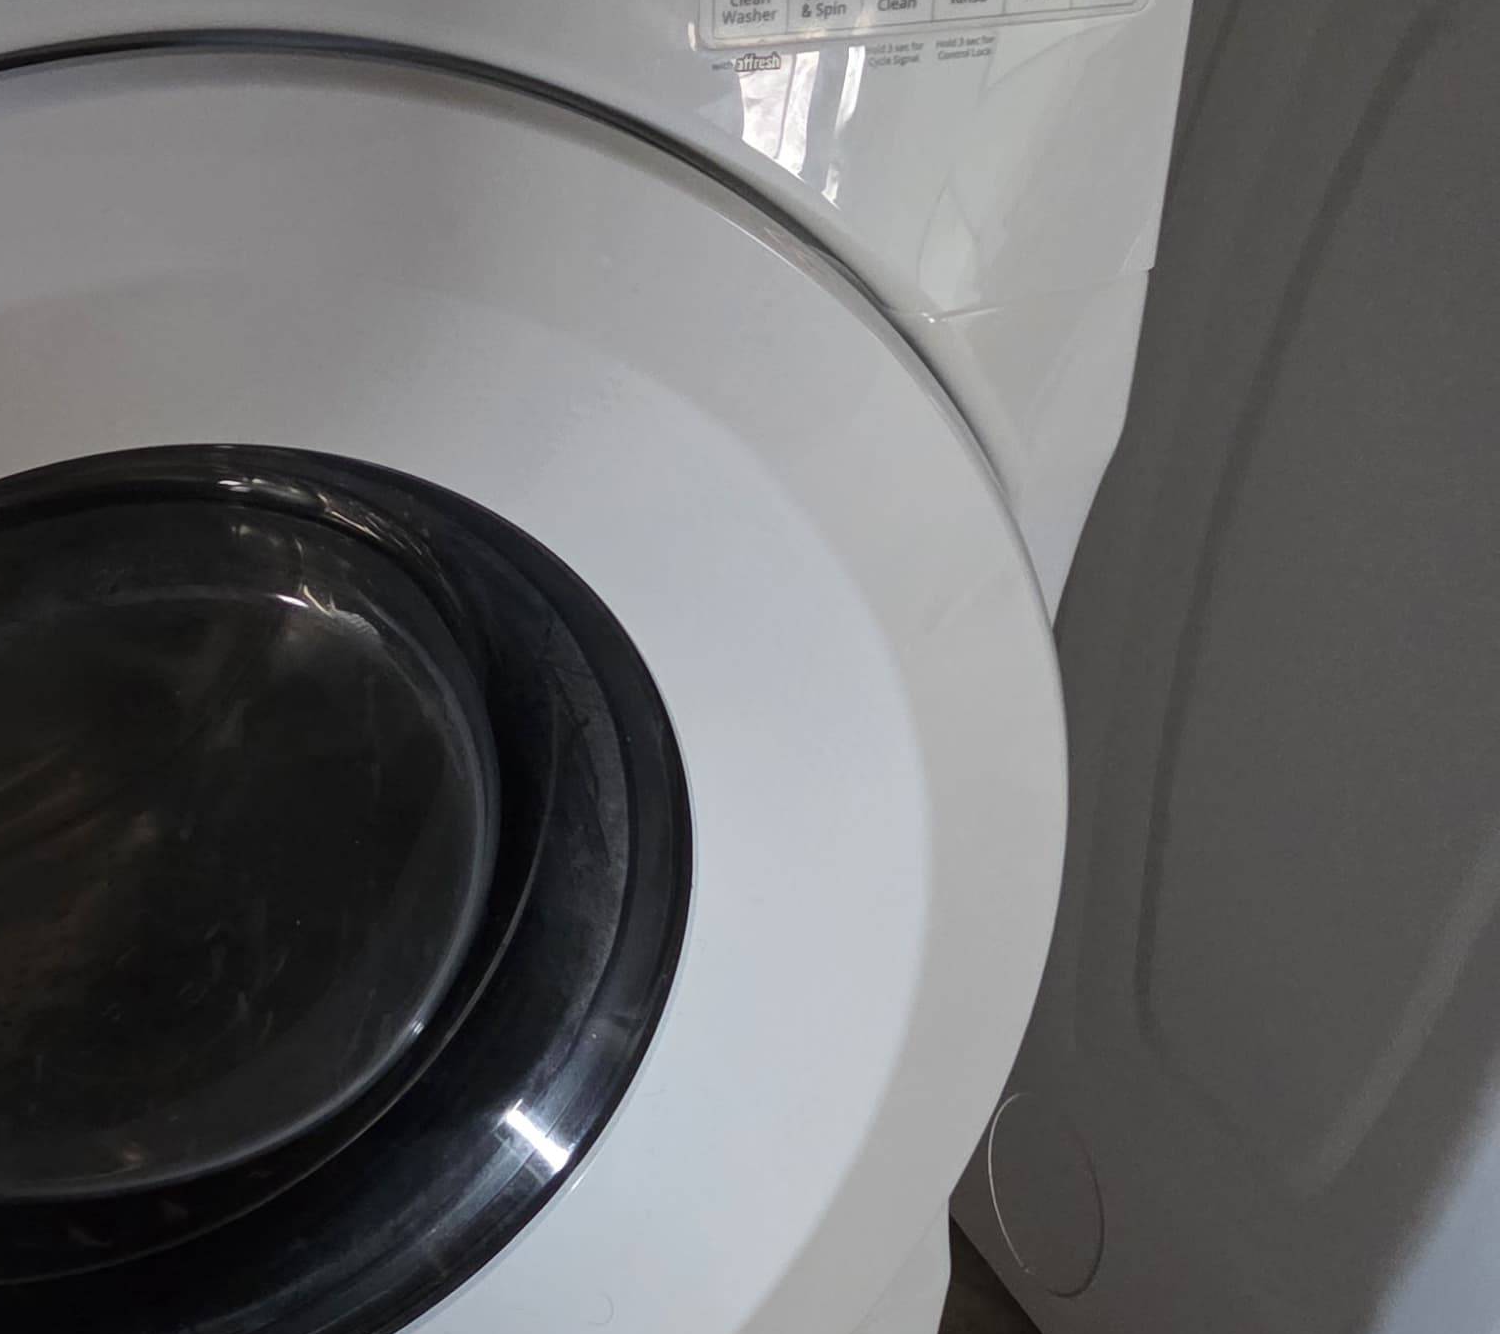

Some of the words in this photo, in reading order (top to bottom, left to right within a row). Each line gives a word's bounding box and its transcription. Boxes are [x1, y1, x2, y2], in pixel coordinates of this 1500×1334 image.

[722, 8, 778, 24] Washer
[801, 3, 812, 18] &
[815, 2, 847, 19] Spin
[735, 51, 781, 72] affresh
